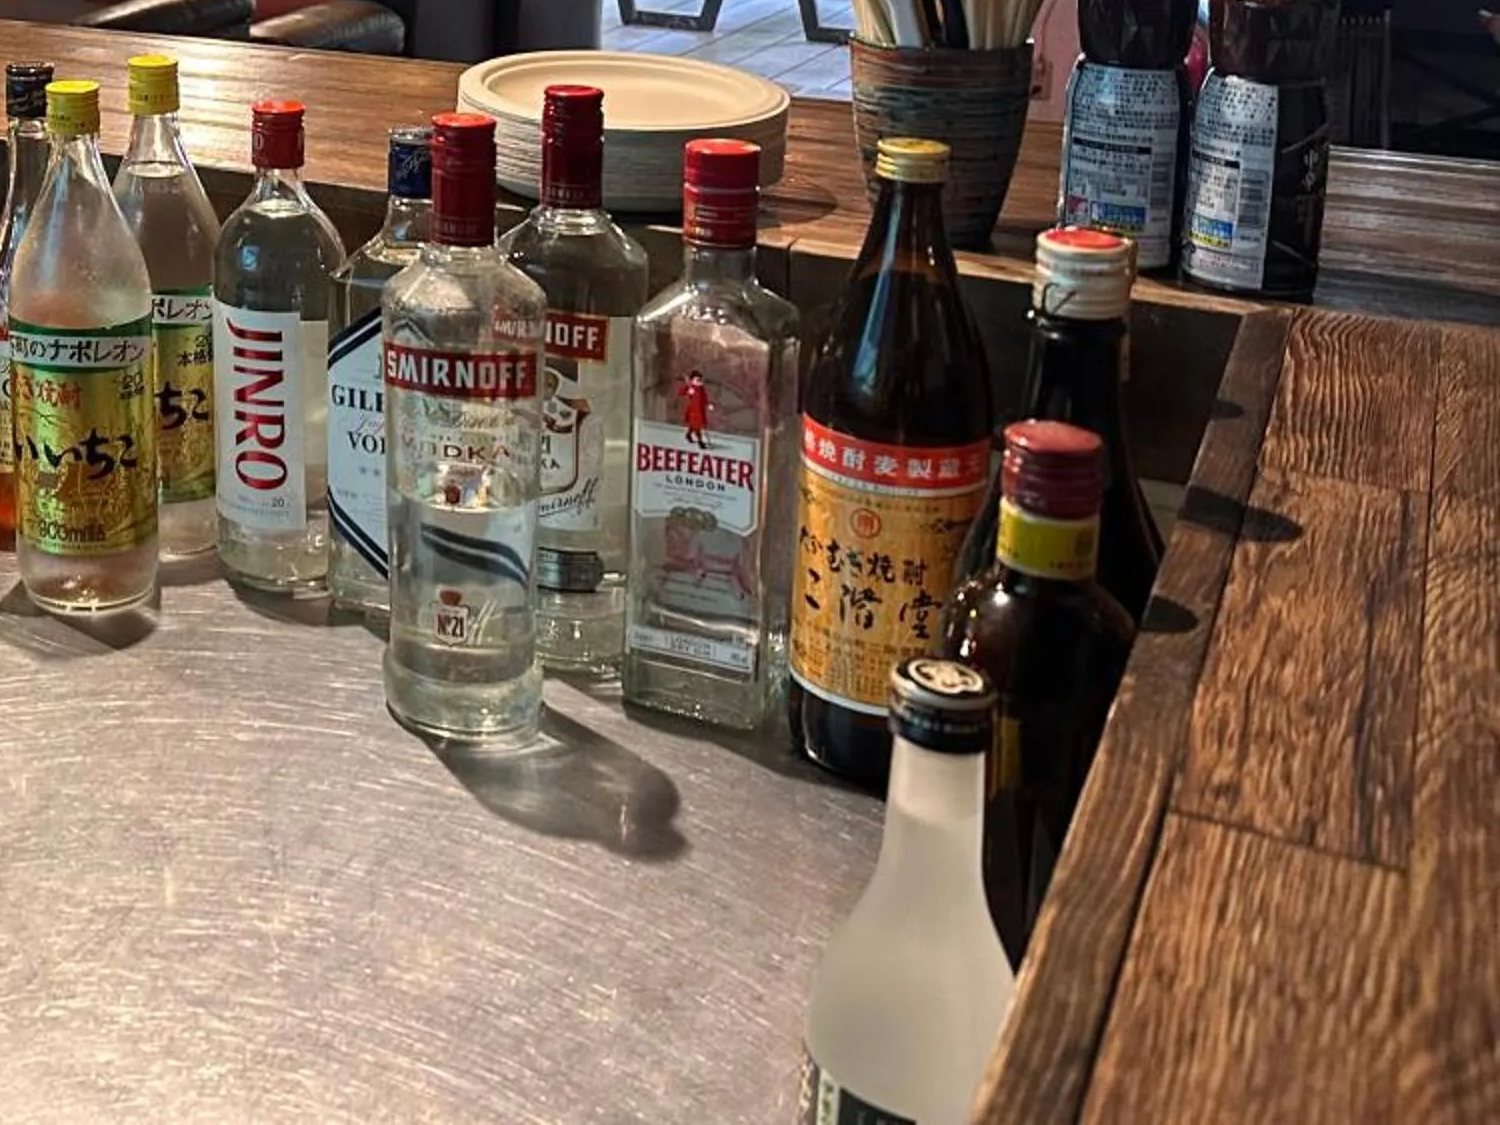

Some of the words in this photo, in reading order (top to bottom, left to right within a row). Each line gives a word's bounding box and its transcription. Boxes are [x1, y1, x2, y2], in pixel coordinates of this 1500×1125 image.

[387, 350, 528, 390] SMIRNOFF
[226, 317, 288, 490] JINRO
[637, 442, 755, 492] BEEFEATER
[665, 474, 725, 492] LONDON
